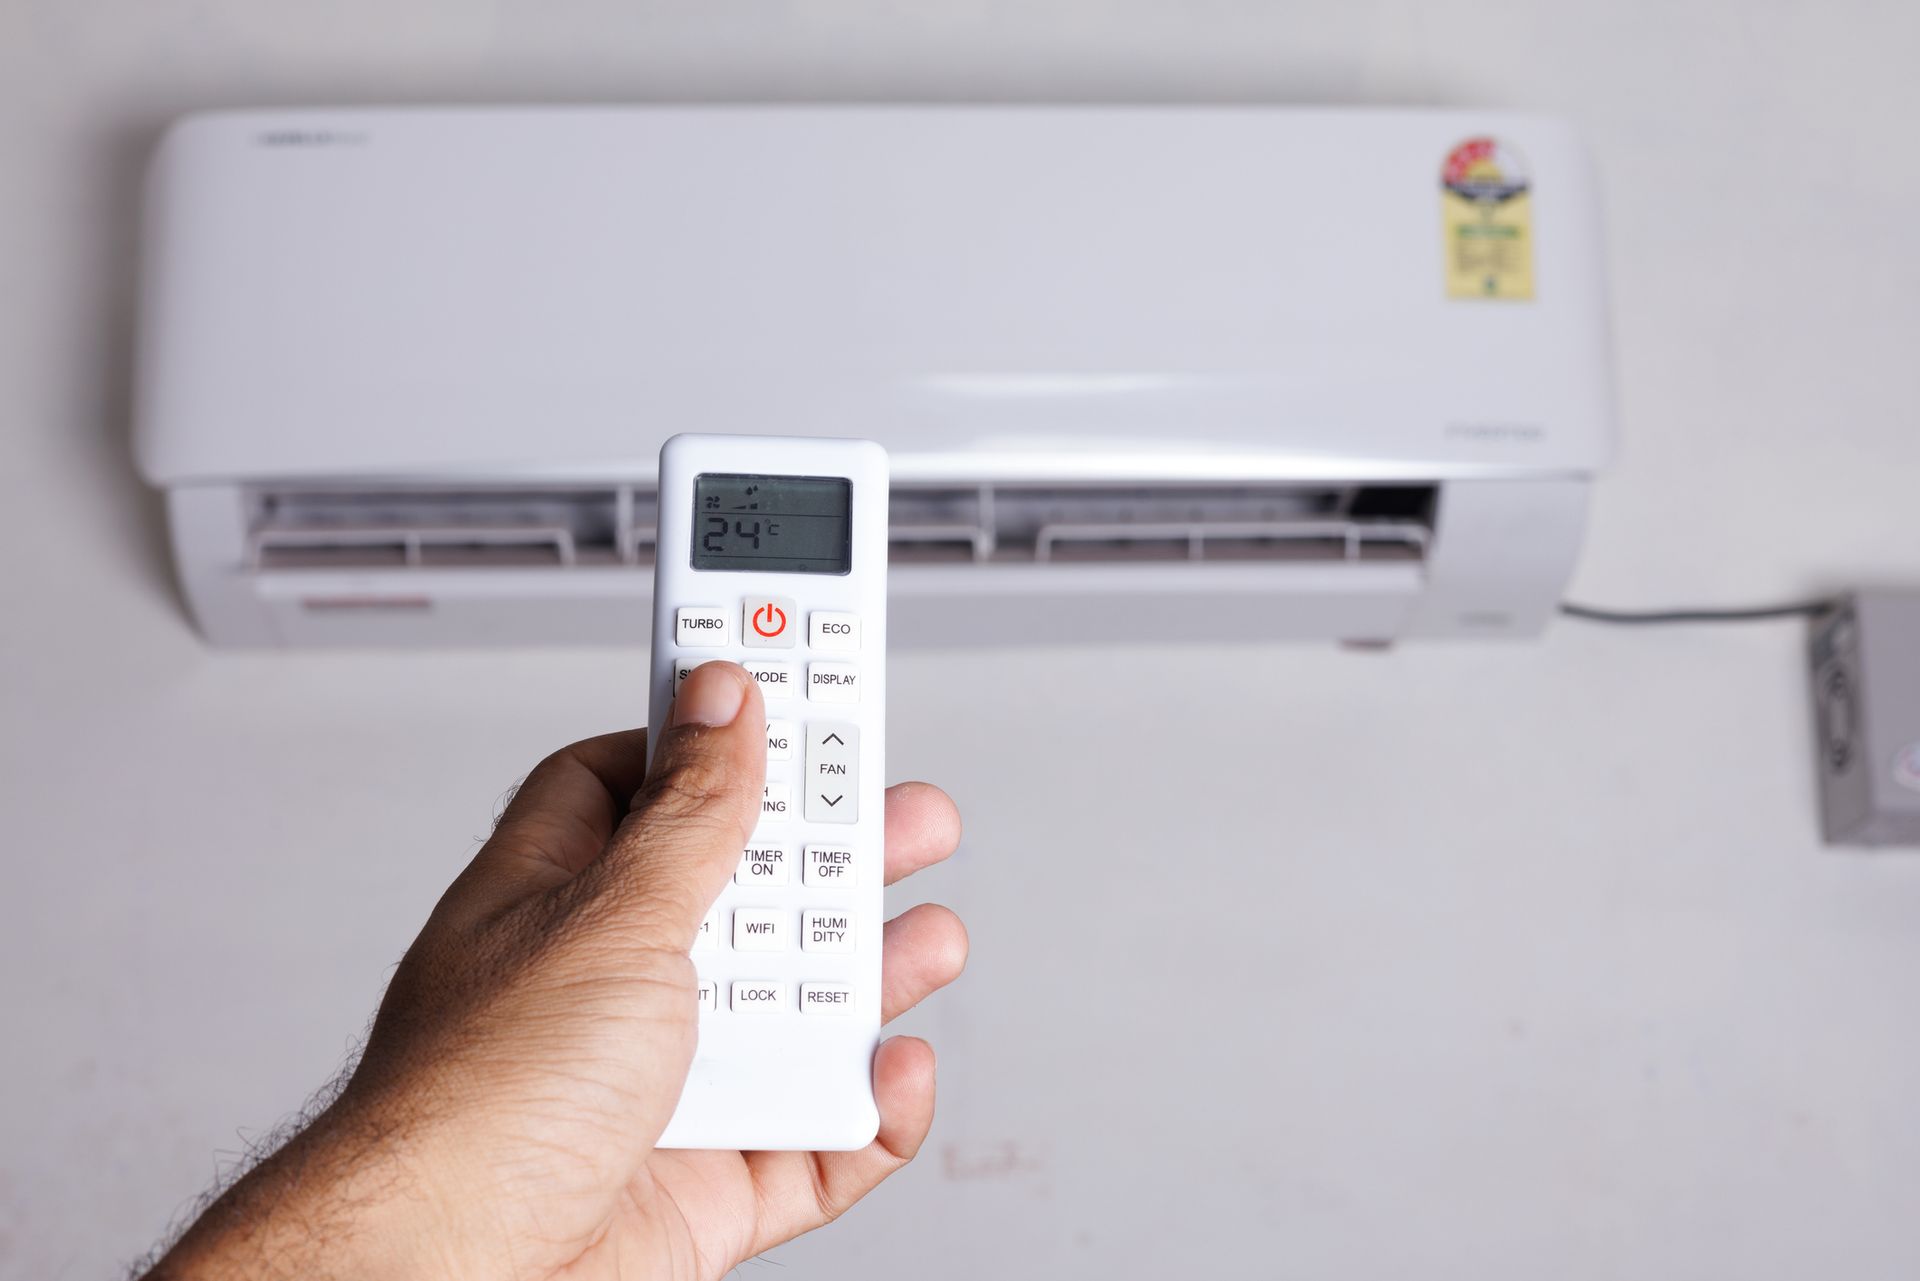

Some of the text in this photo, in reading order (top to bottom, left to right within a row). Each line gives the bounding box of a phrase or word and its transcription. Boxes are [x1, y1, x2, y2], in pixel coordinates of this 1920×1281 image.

[682, 619, 723, 629] TURBO
[823, 624, 850, 635] ECO
[813, 674, 856, 686] DISPLAY
[820, 764, 846, 775] FAN
[744, 850, 783, 862] TIMER
[811, 851, 852, 864] TIMER
[752, 863, 774, 875] ON
[818, 866, 845, 878] OFF
[746, 923, 775, 934] WIFI
[812, 918, 847, 929] HUMI
[813, 931, 845, 942] DITY
[741, 990, 776, 1001] LOCK
[807, 992, 849, 1003] RESET
